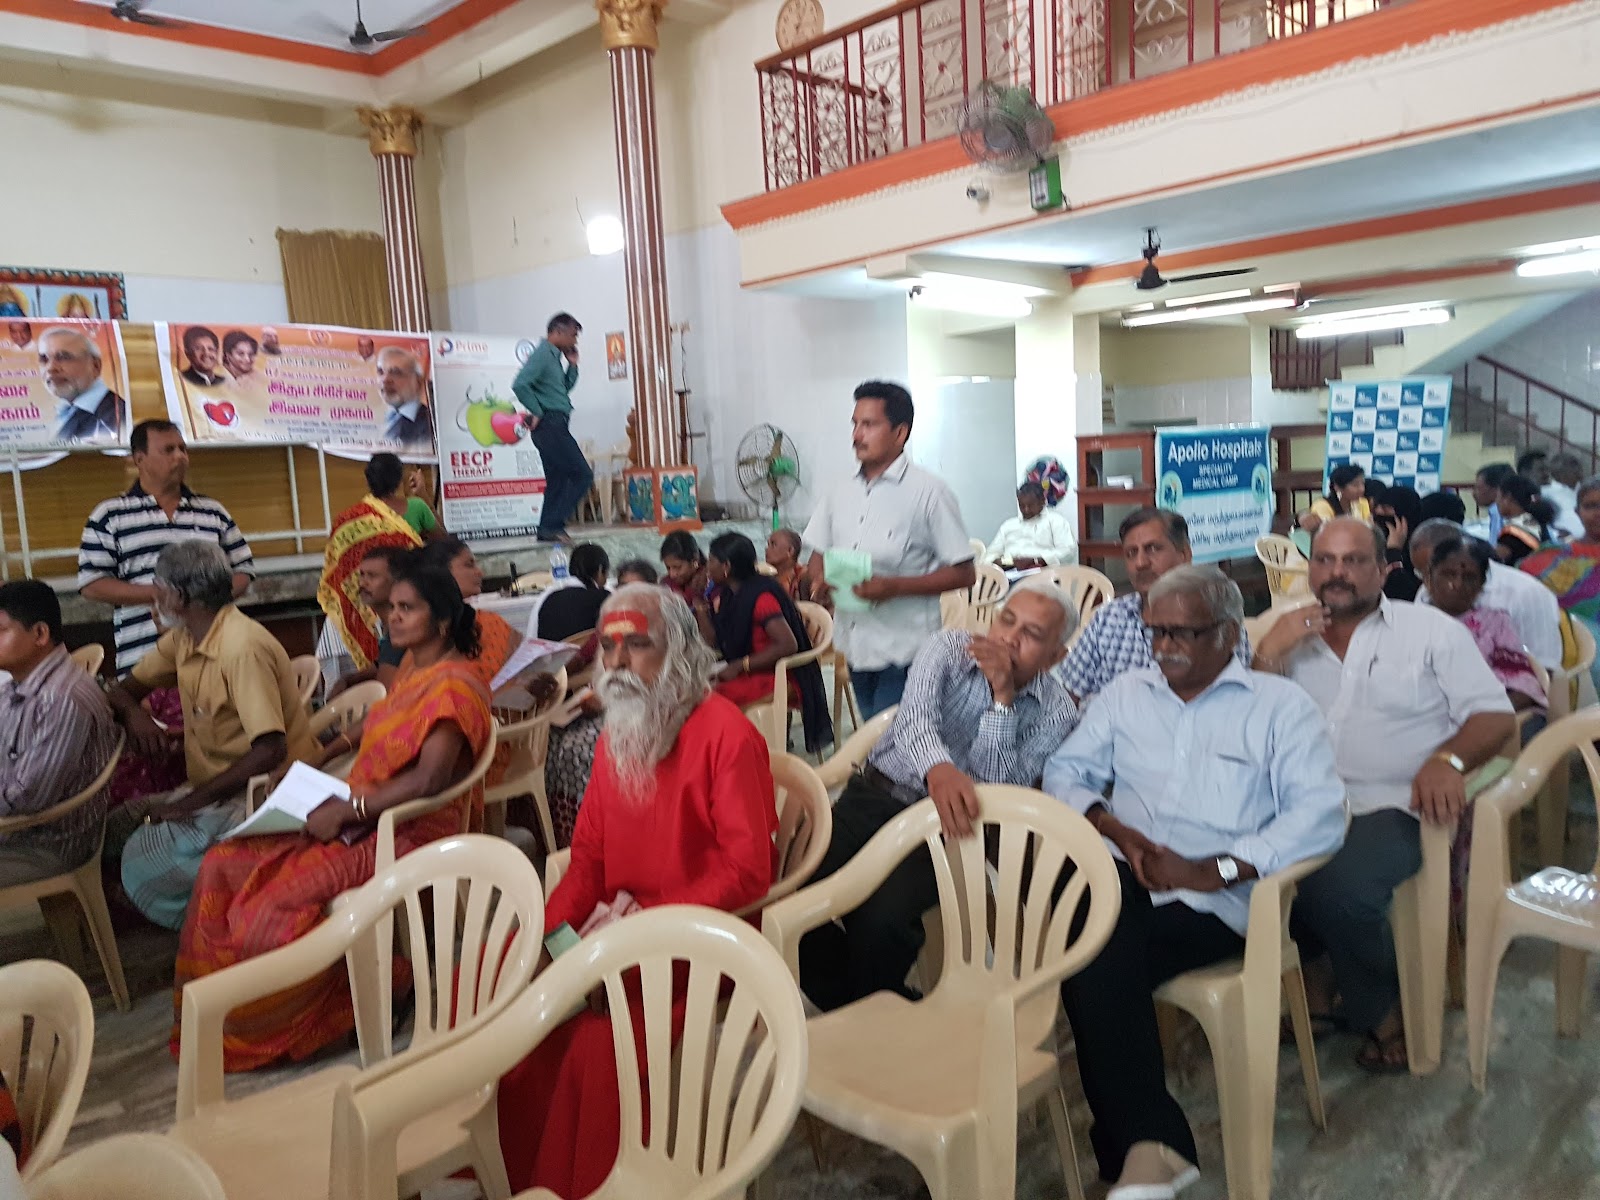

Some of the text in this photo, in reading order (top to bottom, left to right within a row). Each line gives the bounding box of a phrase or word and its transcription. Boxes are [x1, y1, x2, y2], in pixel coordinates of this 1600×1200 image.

[451, 451, 493, 466] EECP
[1168, 437, 1262, 467] Apollo Hospitals
[453, 466, 493, 478] THERAPY
[1198, 462, 1233, 477] SPECIALITY
[1192, 474, 1239, 490] MEDICAL CAMP
